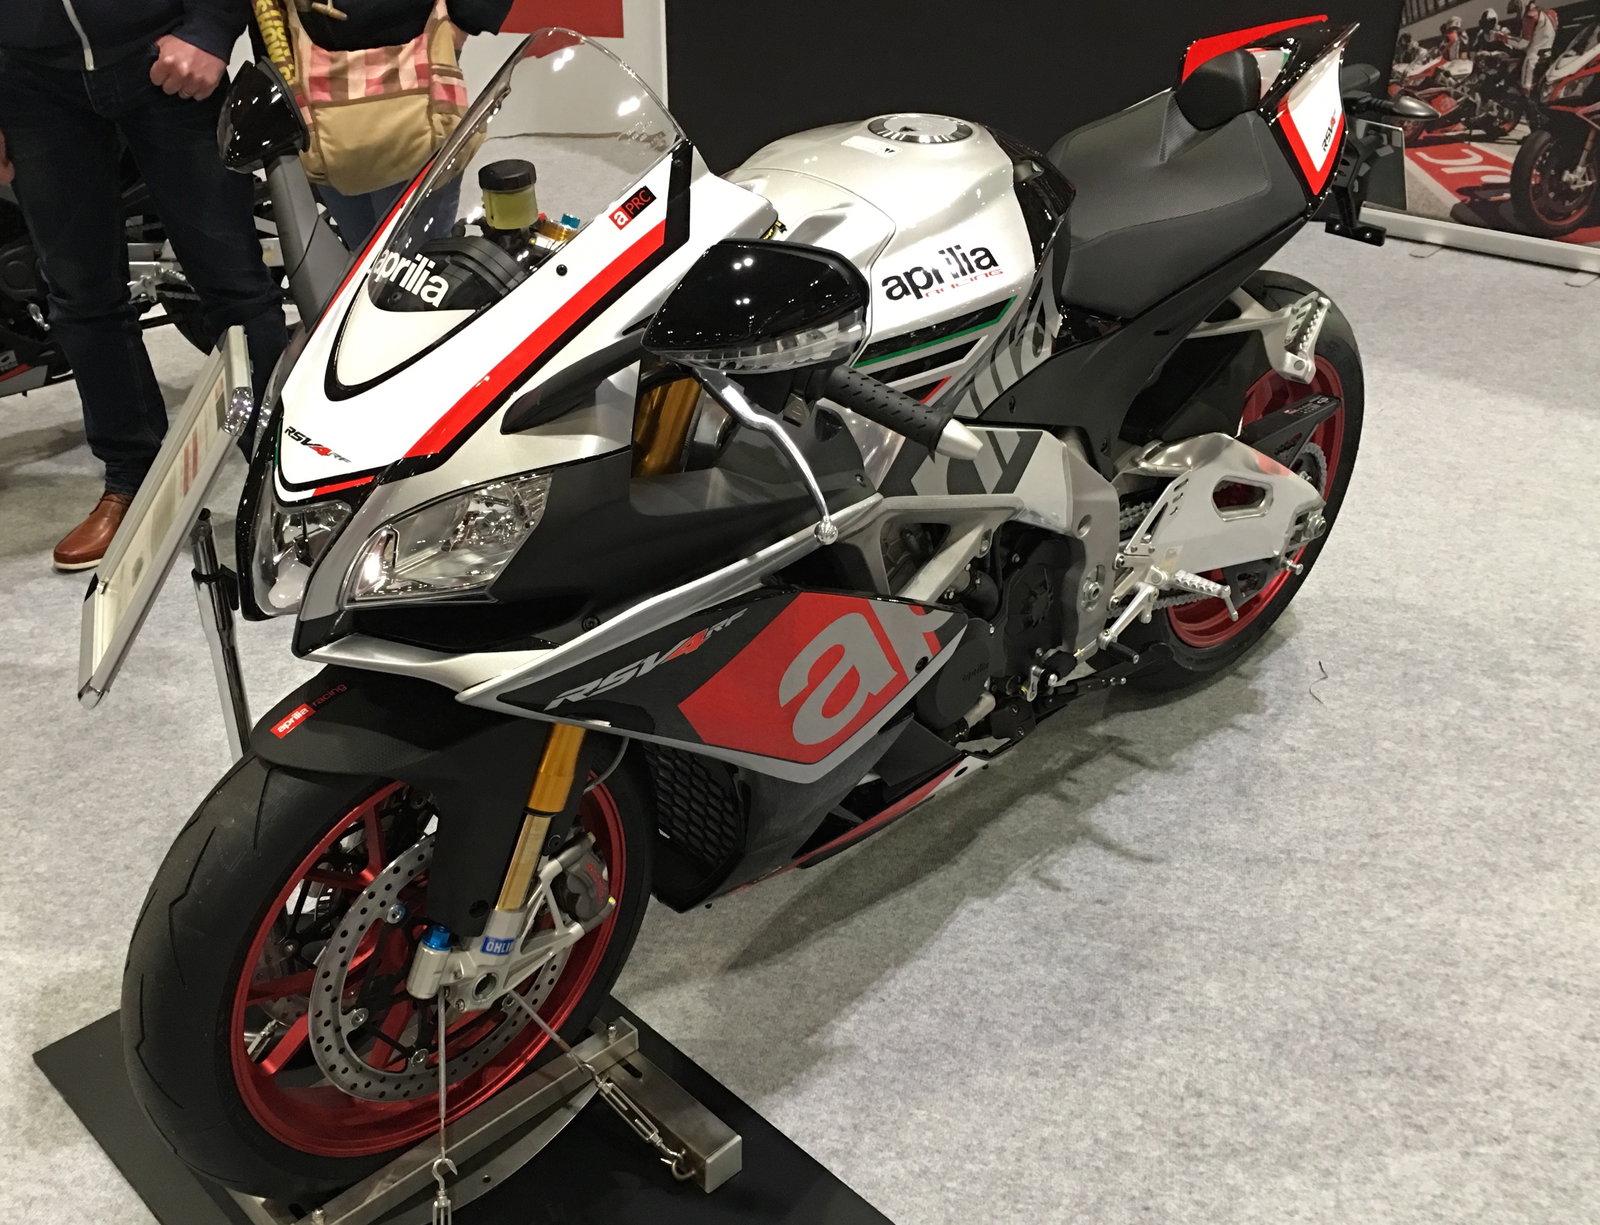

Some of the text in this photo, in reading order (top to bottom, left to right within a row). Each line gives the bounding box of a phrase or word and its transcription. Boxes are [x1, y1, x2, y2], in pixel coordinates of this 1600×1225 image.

[625, 190, 651, 215] PRC
[373, 249, 450, 308] aprilia
[882, 244, 1000, 301] aprilia
[277, 707, 309, 733] aprilia
